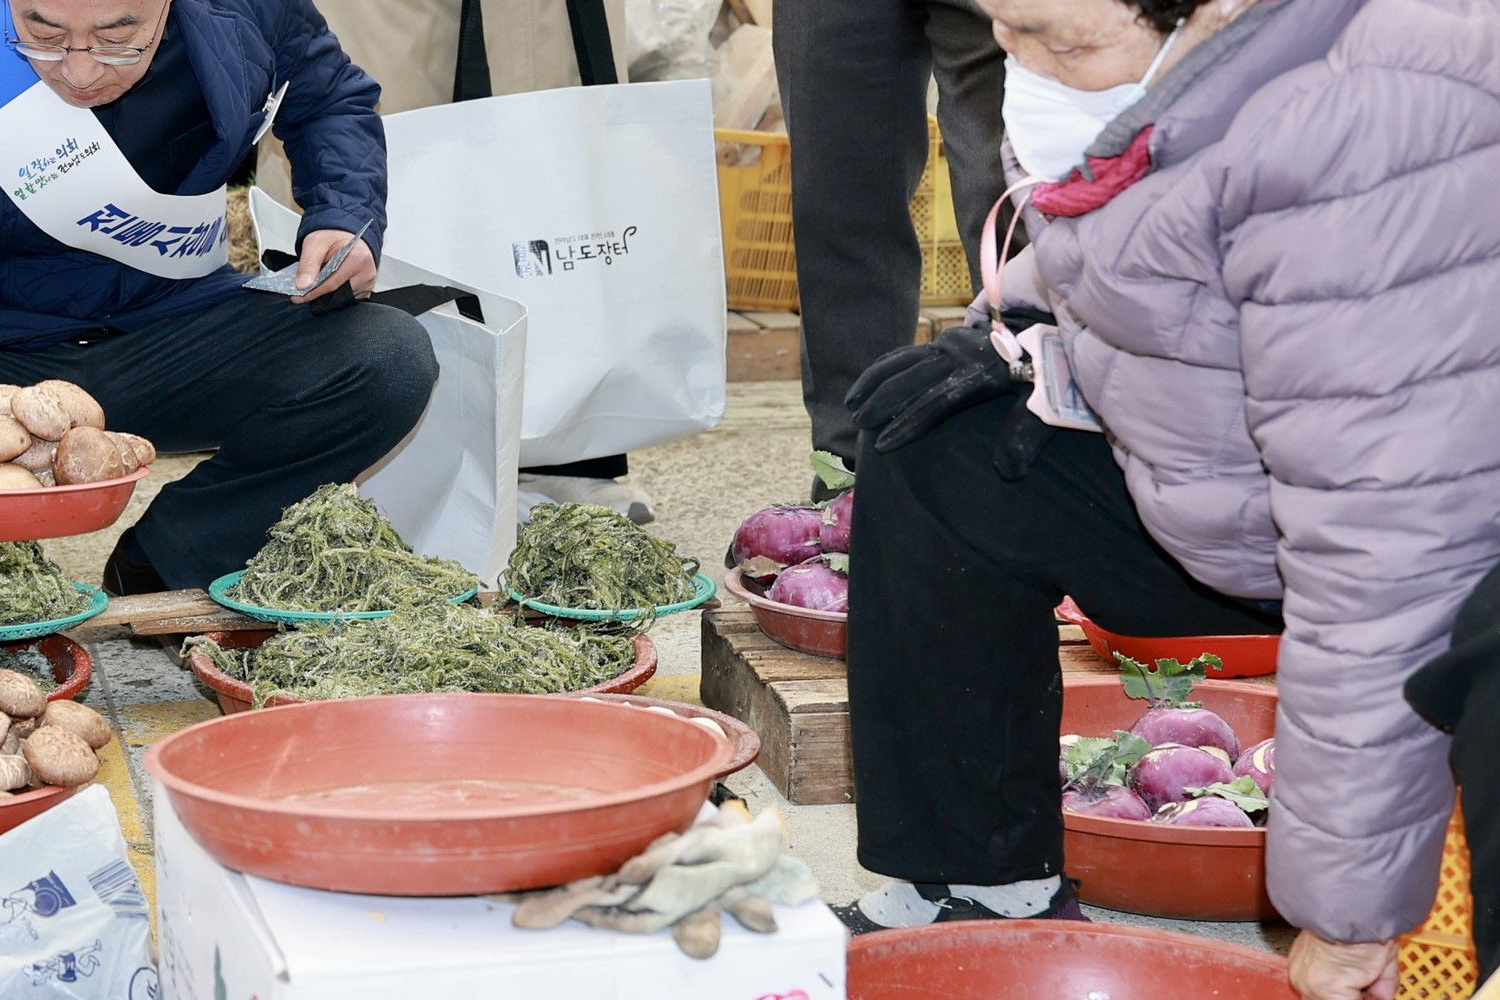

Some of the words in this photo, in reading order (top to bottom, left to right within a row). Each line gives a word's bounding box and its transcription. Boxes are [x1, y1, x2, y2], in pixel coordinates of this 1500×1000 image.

[56, 138, 79, 159] 의회
[57, 141, 101, 174] 전라남도의회
[555, 226, 638, 271] 남도장터
